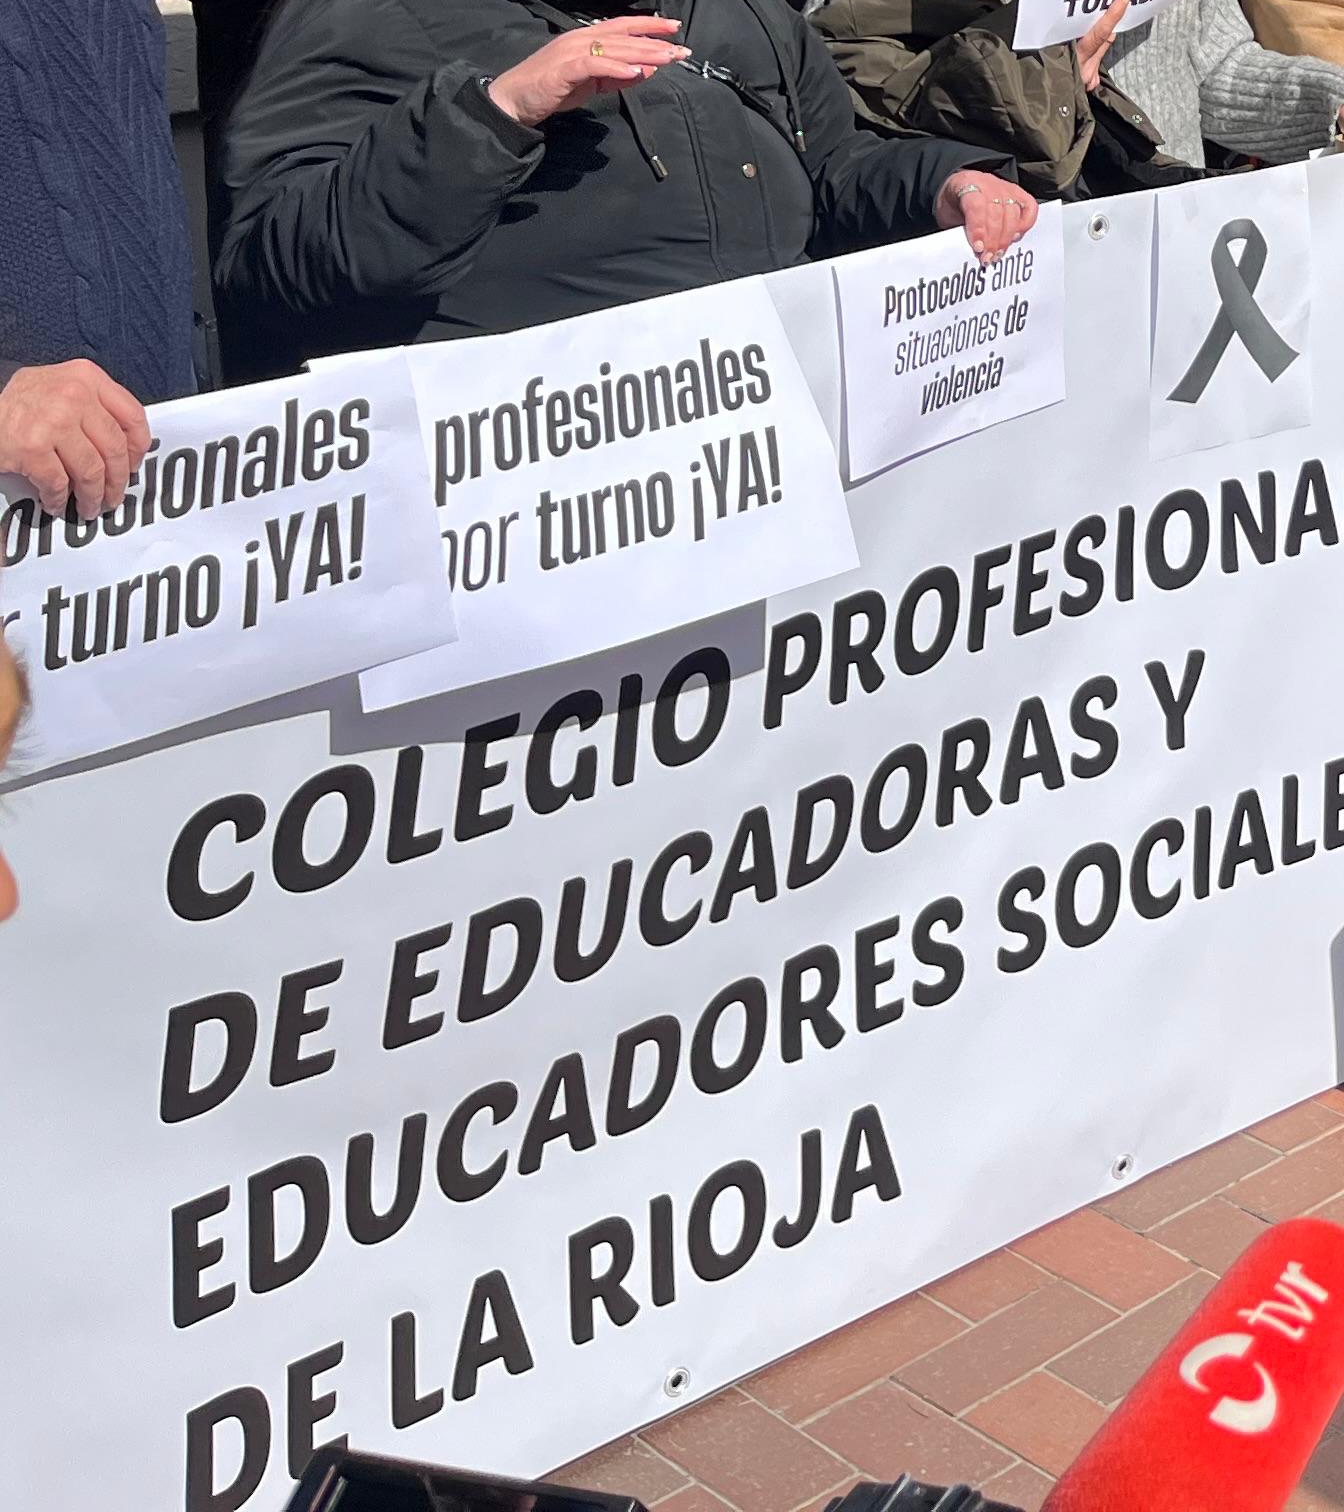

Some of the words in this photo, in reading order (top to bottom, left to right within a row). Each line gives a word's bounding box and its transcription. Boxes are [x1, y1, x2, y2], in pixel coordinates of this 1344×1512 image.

[884, 261, 987, 328] Protocolos
[991, 247, 1034, 292] ante
[895, 309, 1001, 376] situaciones
[1004, 294, 1029, 337] de
[435, 337, 771, 508] profesionales
[920, 351, 1005, 416] violencia
[42, 554, 222, 671] turno
[242, 492, 367, 630] ¡YA!
[537, 470, 675, 572] turno
[691, 424, 783, 543] ¡YA!
[165, 645, 730, 921] COLEGIO
[159, 959, 345, 1124] DE
[381, 674, 1120, 1050] EDUCADORAS
[1144, 649, 1206, 750] Y
[171, 896, 965, 1329] EDUCADORES
[184, 1340, 349, 1512] DE
[390, 1269, 534, 1429] LA
[567, 1103, 903, 1346] RIOJA
[1237, 1259, 1331, 1341] tvr
